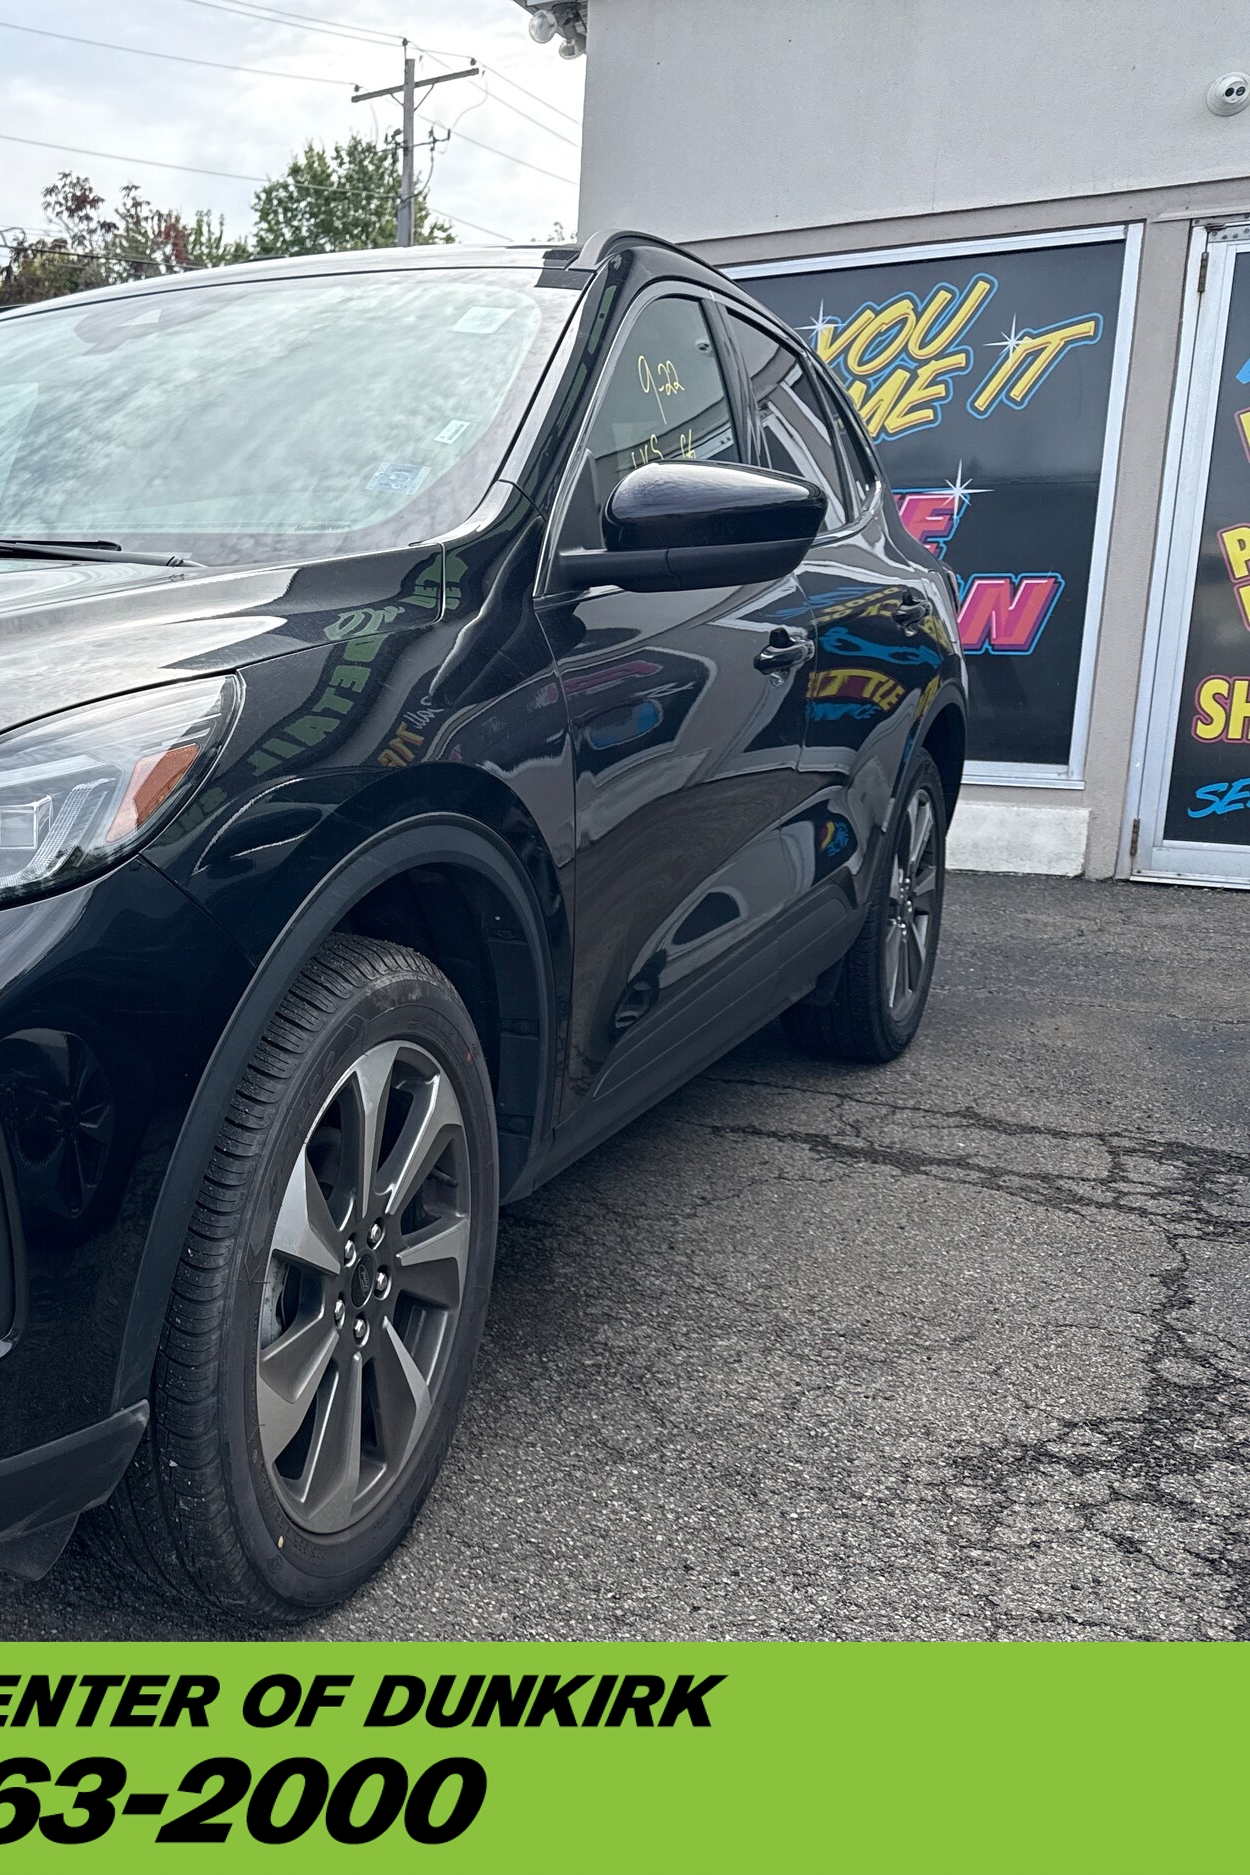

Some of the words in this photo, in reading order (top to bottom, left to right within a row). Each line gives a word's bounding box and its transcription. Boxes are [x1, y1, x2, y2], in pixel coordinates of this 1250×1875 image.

[817, 280, 991, 375] YOU
[851, 354, 966, 438] ME
[975, 321, 1095, 411] IT
[1196, 677, 1250, 740] SH
[1187, 774, 1250, 818] SE
